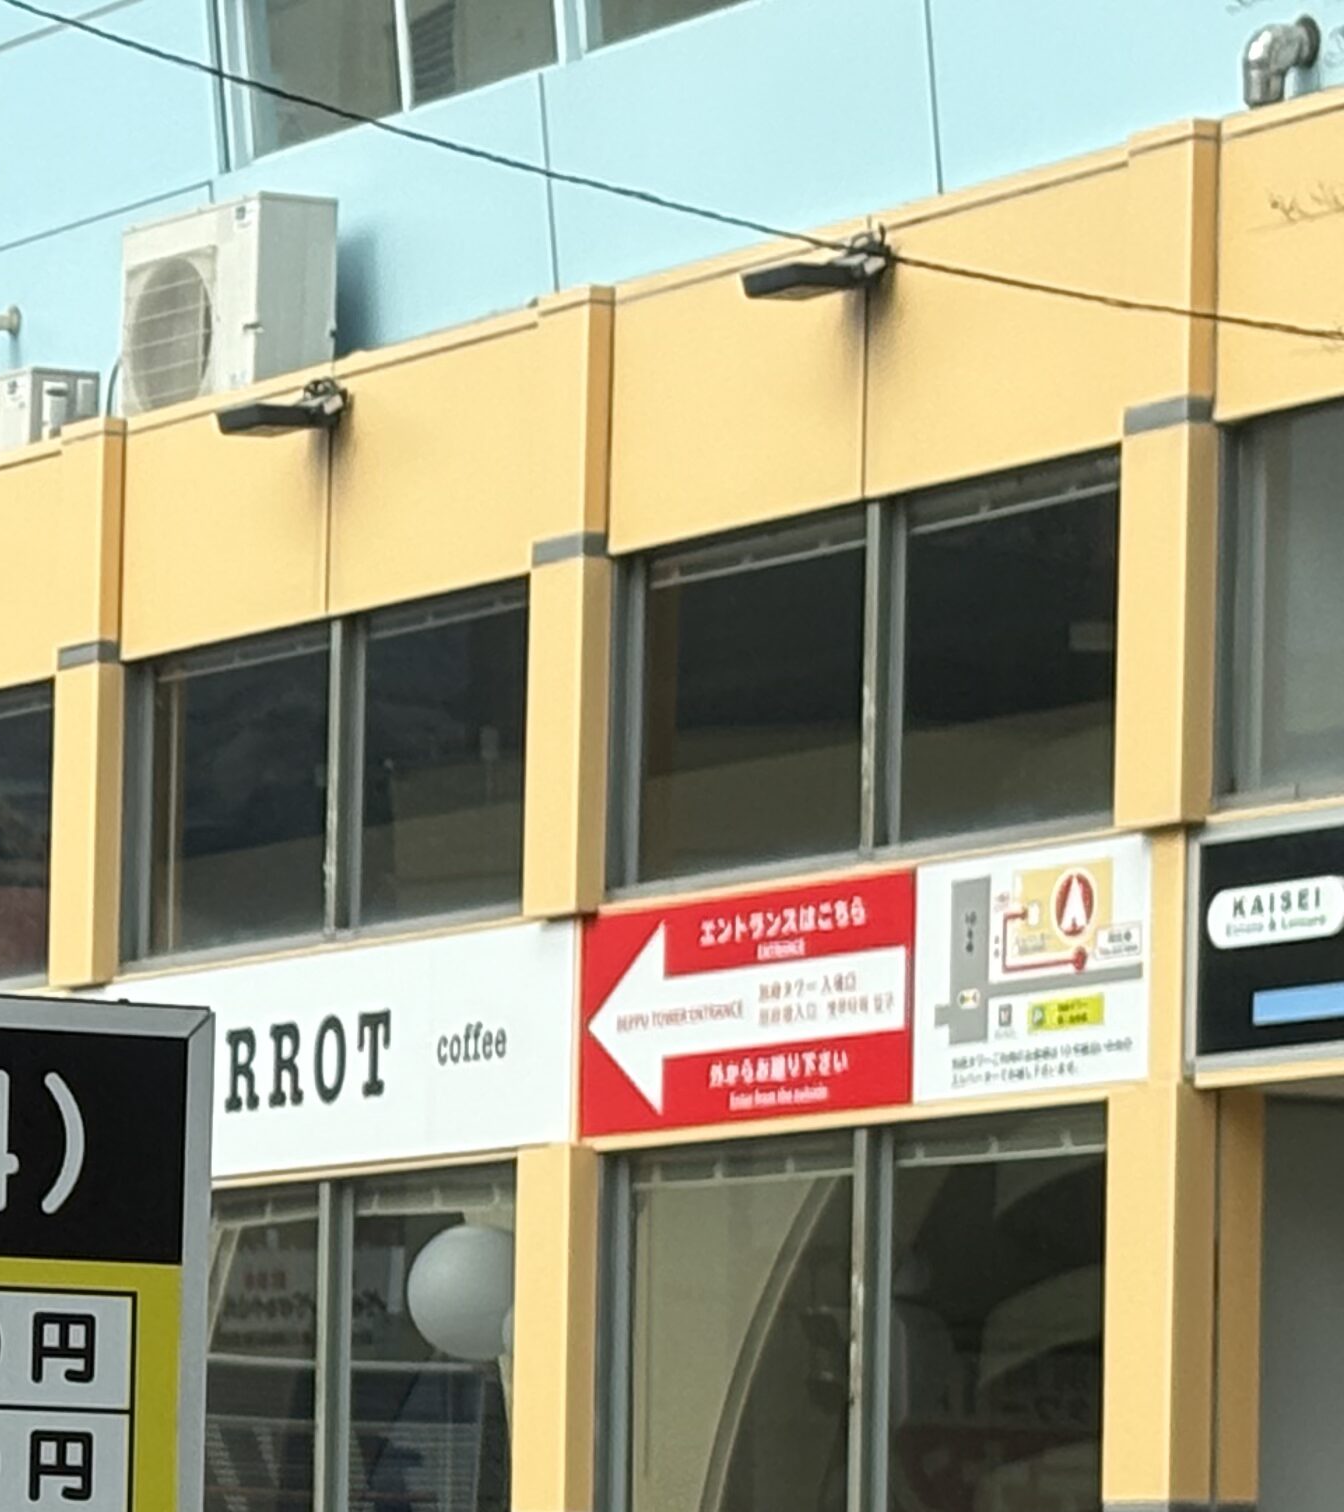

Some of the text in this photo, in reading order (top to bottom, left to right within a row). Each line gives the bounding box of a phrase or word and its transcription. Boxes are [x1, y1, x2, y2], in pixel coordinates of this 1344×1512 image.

[1232, 886, 1321, 919] KAISEI
[224, 1008, 508, 1113] RROT coffee
